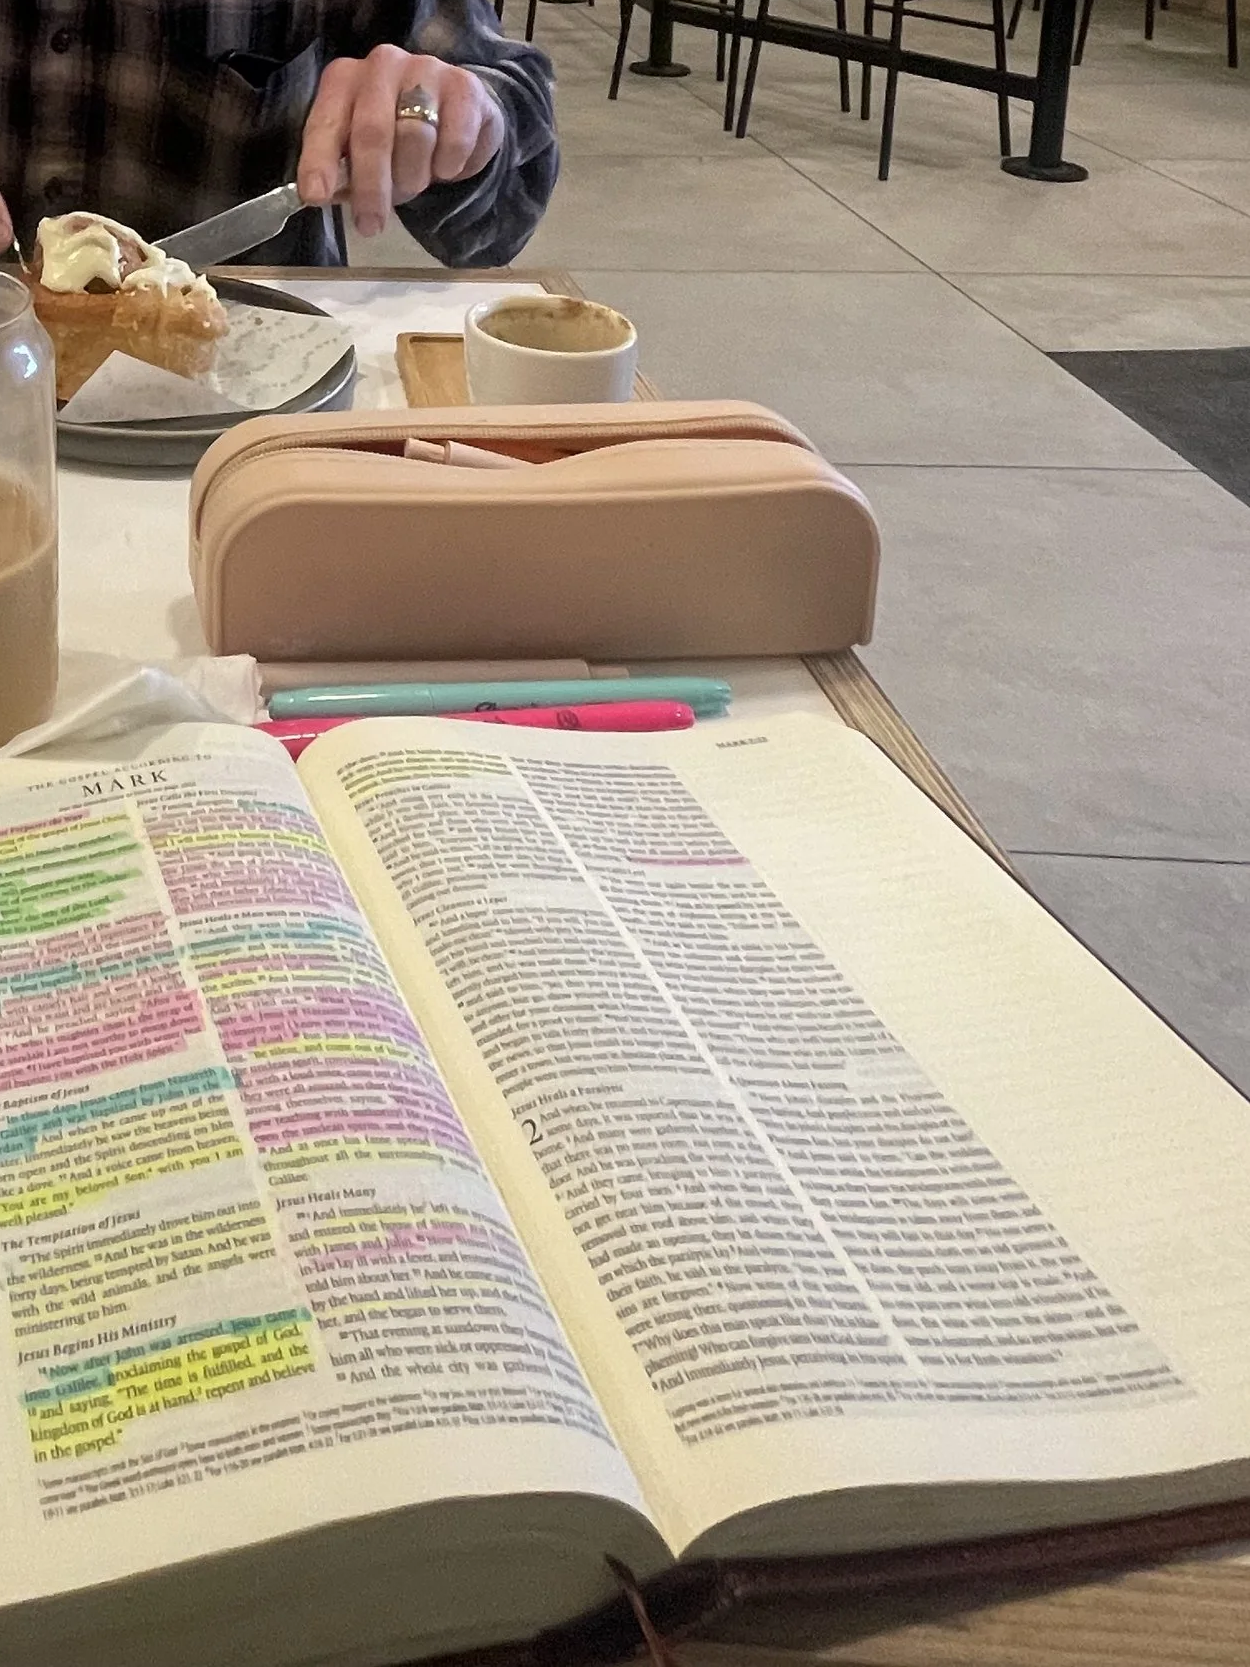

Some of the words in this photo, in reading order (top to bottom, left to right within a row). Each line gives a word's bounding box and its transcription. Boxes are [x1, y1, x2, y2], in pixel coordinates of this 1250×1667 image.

[28, 782, 53, 792] THE
[59, 770, 108, 784] GOSPEL
[114, 755, 190, 773] ACCORDING
[82, 770, 168, 798] MARK
[3, 1094, 48, 1109] Baptism
[51, 1089, 62, 1100] of
[63, 1085, 90, 1098] Jesus
[510, 1101, 537, 1119] Jesus
[521, 1119, 543, 1146] 2
[276, 1196, 305, 1212] Jesus
[308, 1190, 340, 1202] Heals
[343, 1187, 376, 1199] Many
[1, 1241, 23, 1252] The
[26, 1223, 96, 1246] Temptation
[98, 1217, 109, 1230] of
[112, 1210, 141, 1227] Jesus
[53, 1243, 85, 1259] Spirit
[86, 1224, 156, 1251] immediately
[158, 1216, 190, 1232] drove
[191, 1210, 216, 1223] him
[216, 1206, 236, 1217] out
[238, 1200, 261, 1212] into
[294, 1244, 320, 1258] with
[361, 1237, 382, 1249] and
[6, 1273, 26, 1286] the
[104, 1248, 129, 1263] And
[131, 1244, 145, 1255] he
[147, 1238, 169, 1249] was
[171, 1235, 183, 1245] in
[185, 1230, 204, 1241] the
[205, 1216, 266, 1235] wilderness
[9, 1289, 37, 1303] forty
[70, 1274, 104, 1289] being
[104, 1257, 154, 1280] tempted
[154, 1255, 169, 1267] by
[207, 1238, 232, 1254] And
[232, 1236, 248, 1247] he
[250, 1232, 272, 1244] was
[11, 1304, 40, 1319] with
[45, 1301, 64, 1313] the
[69, 1290, 97, 1306] wild
[156, 1268, 178, 1284] and
[183, 1264, 202, 1277] the
[207, 1254, 244, 1271] angels
[248, 1248, 277, 1260] were
[14, 1310, 86, 1337] ministering
[87, 1310, 100, 1321] to
[18, 1349, 50, 1366] Jesus
[53, 1338, 95, 1357] Begins
[97, 1330, 119, 1345] His
[121, 1315, 177, 1339] Ministry
[47, 1363, 79, 1378] Now
[84, 1355, 111, 1369] after
[115, 1345, 146, 1363] John
[150, 1338, 172, 1351] was
[230, 1316, 262, 1334] Jesus
[264, 1309, 297, 1323] came
[25, 1389, 50, 1402] into
[107, 1355, 182, 1386] proclaiming
[186, 1349, 208, 1363] the
[212, 1336, 251, 1358] gospel
[256, 1331, 268, 1345] of
[40, 1400, 63, 1420] and
[154, 1375, 183, 1391] time
[188, 1371, 198, 1382] is
[260, 1347, 283, 1364] and
[289, 1343, 309, 1357] the
[350, 1367, 376, 1384] And
[380, 1364, 402, 1378] the
[406, 1363, 444, 1375] whole
[448, 1361, 470, 1374] city
[30, 1421, 89, 1443] kingdom
[91, 1414, 104, 1429] of
[106, 1406, 134, 1424] God
[135, 1404, 146, 1417] is
[148, 1401, 160, 1413] at
[205, 1379, 245, 1400] repent
[248, 1370, 271, 1387] and
[272, 1362, 316, 1381] believe
[34, 1450, 48, 1463] in
[51, 1445, 72, 1460] the
